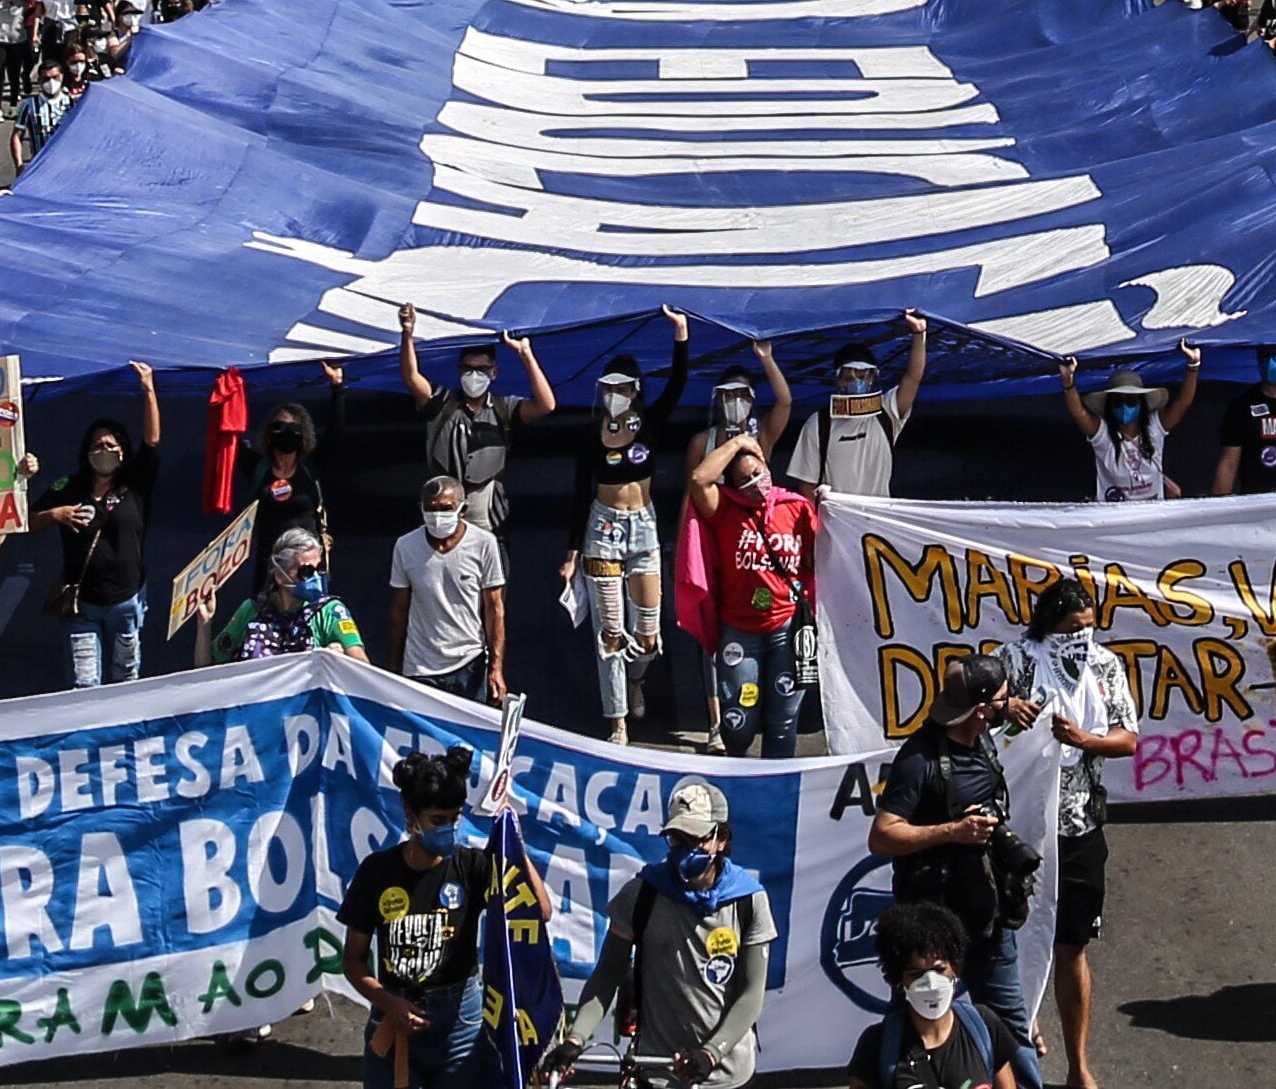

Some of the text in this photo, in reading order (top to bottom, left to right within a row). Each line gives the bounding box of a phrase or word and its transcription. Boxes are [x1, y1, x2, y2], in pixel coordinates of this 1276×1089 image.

[181, 538, 249, 621] BOZO
[184, 516, 253, 593] FORA
[15, 724, 266, 820] DEFESA
[282, 713, 357, 779] DA
[388, 913, 443, 950] REVOLTA
